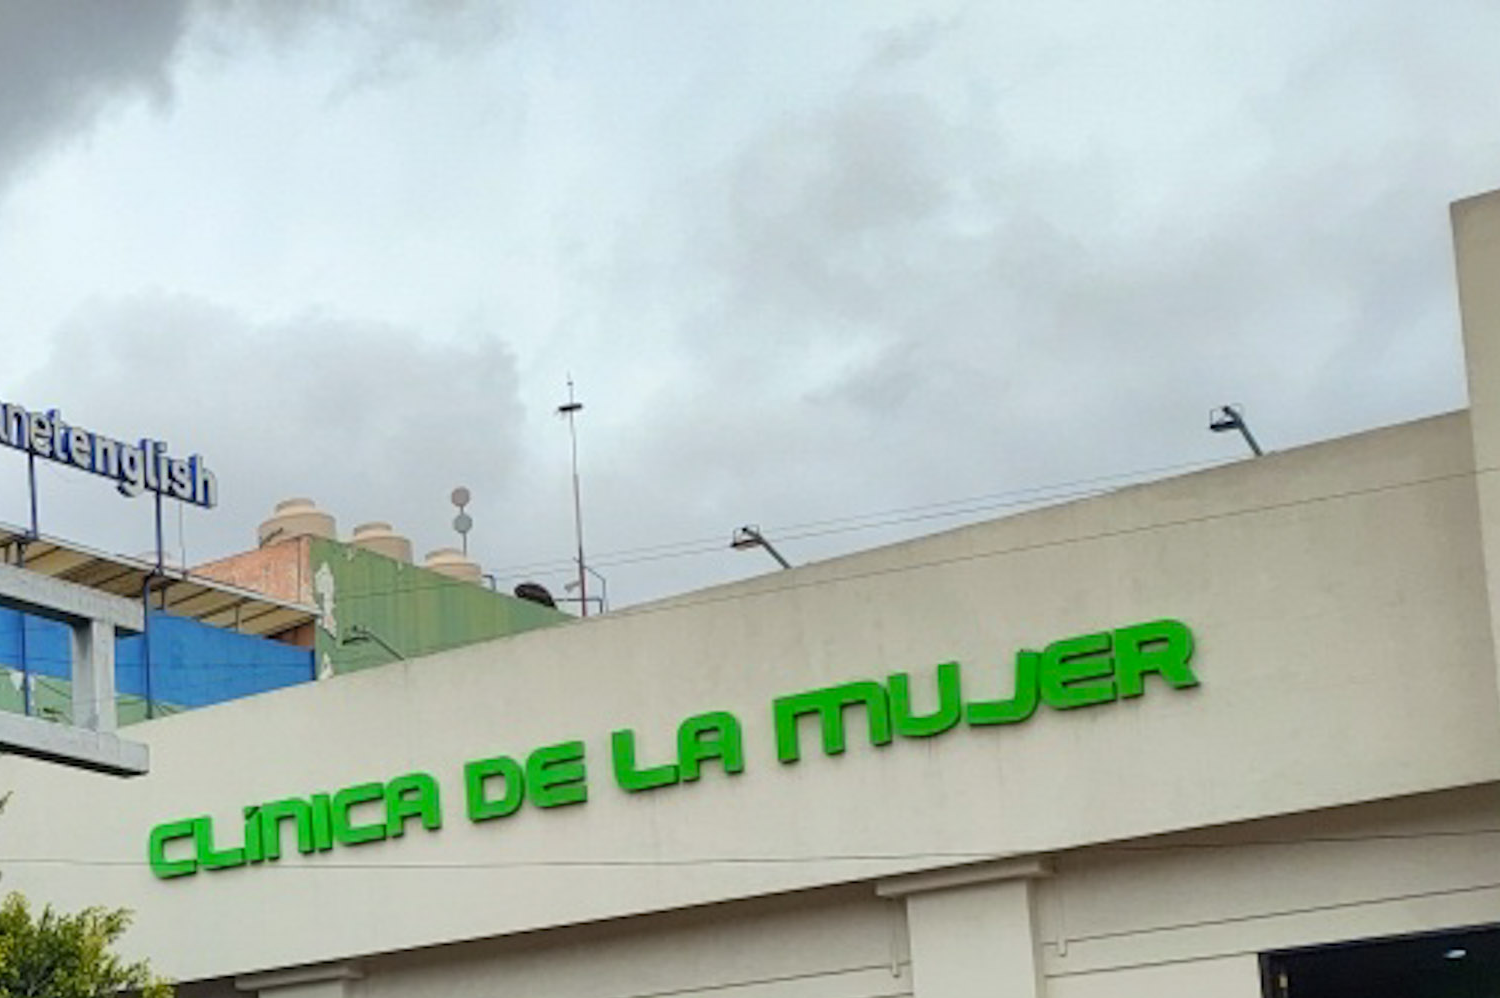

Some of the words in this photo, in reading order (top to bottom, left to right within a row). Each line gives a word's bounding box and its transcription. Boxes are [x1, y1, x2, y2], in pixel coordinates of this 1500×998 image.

[146, 770, 443, 880] CLÍNICA
[463, 741, 590, 822] DE
[611, 711, 746, 792] LA
[772, 616, 1200, 764] MUJER
